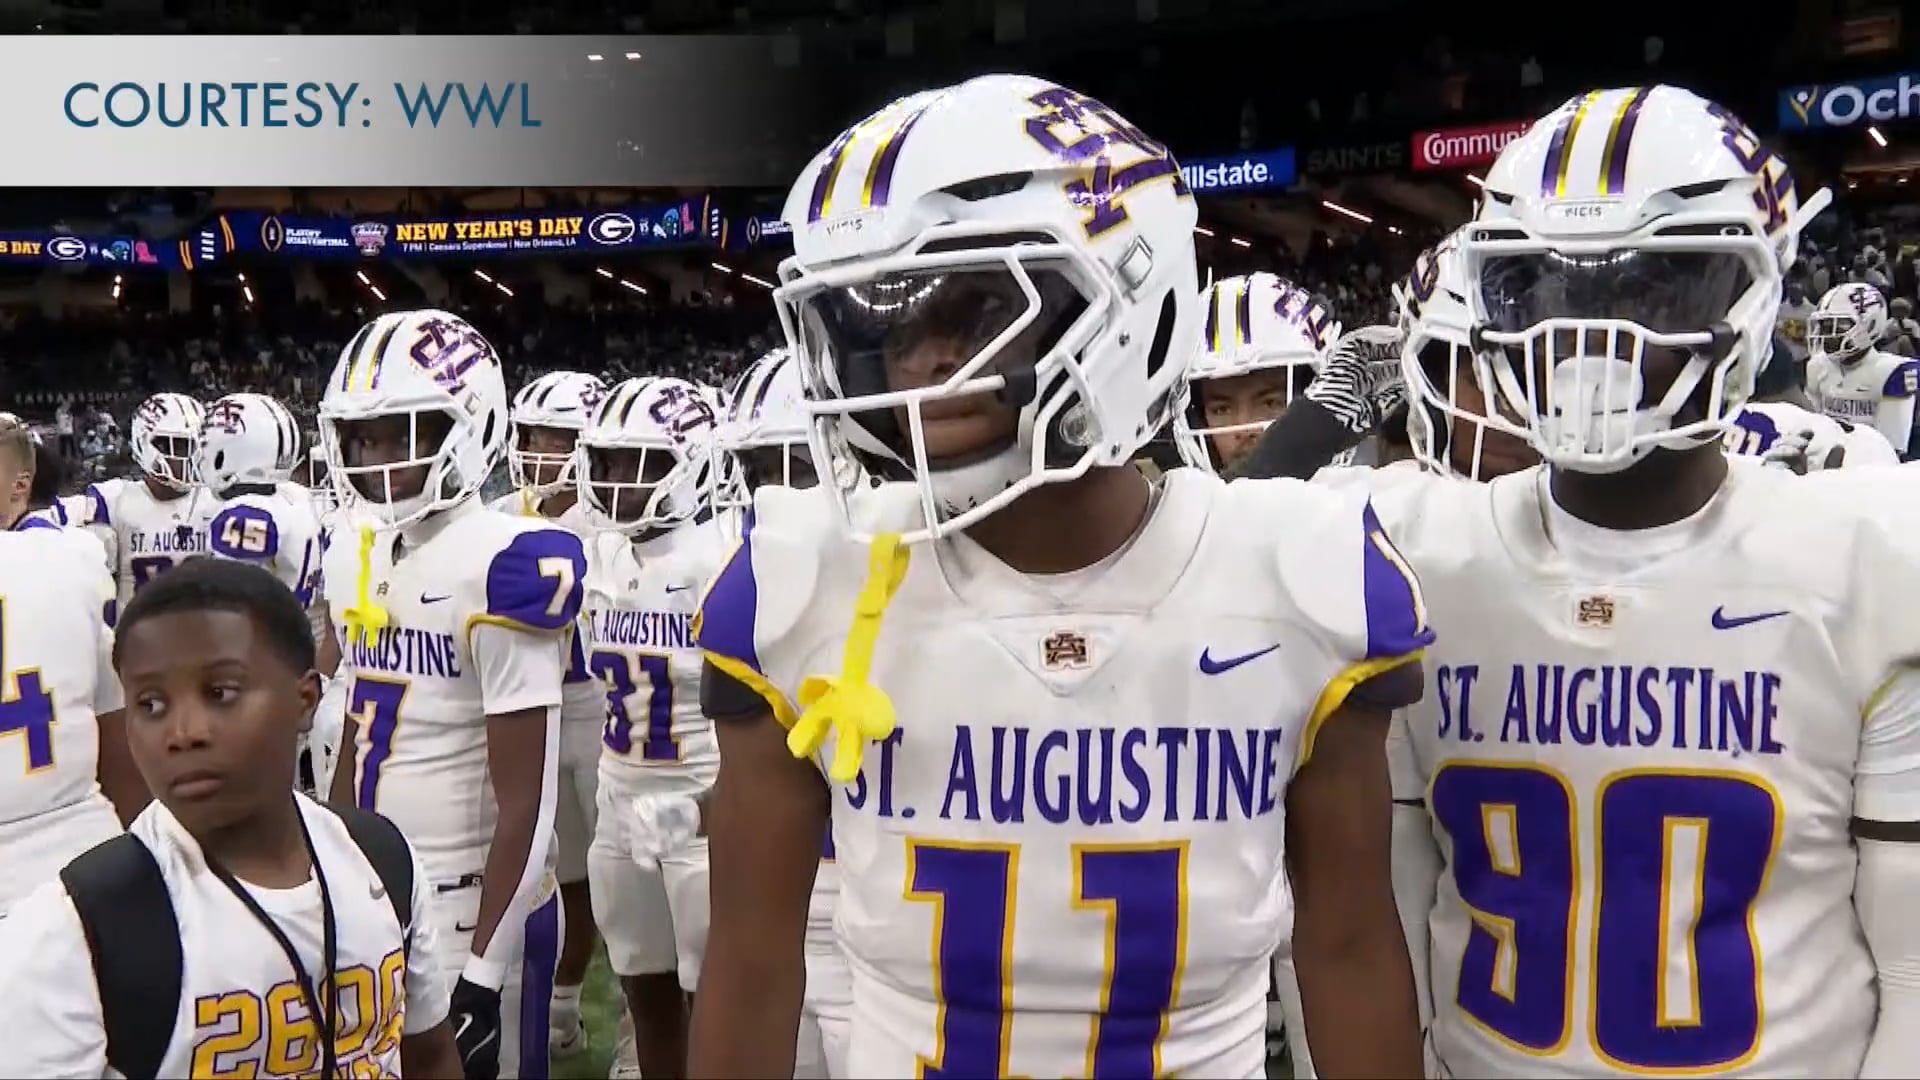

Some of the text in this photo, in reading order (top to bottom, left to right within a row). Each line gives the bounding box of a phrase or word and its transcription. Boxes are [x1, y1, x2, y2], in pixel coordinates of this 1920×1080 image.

[11, 241, 41, 255] DAY
[396, 223, 448, 241] NEW
[454, 219, 533, 239] YEAR'S
[539, 217, 583, 236] DAY
[130, 532, 148, 552] ST.
[220, 516, 270, 553] 45
[538, 557, 575, 617] 7
[349, 673, 412, 813] 7
[1436, 663, 1785, 757] ST. AUGUSTINE
[939, 725, 1282, 825] AUGUSTINE
[1427, 757, 1784, 1076] 90
[903, 838, 1191, 1079] 11
